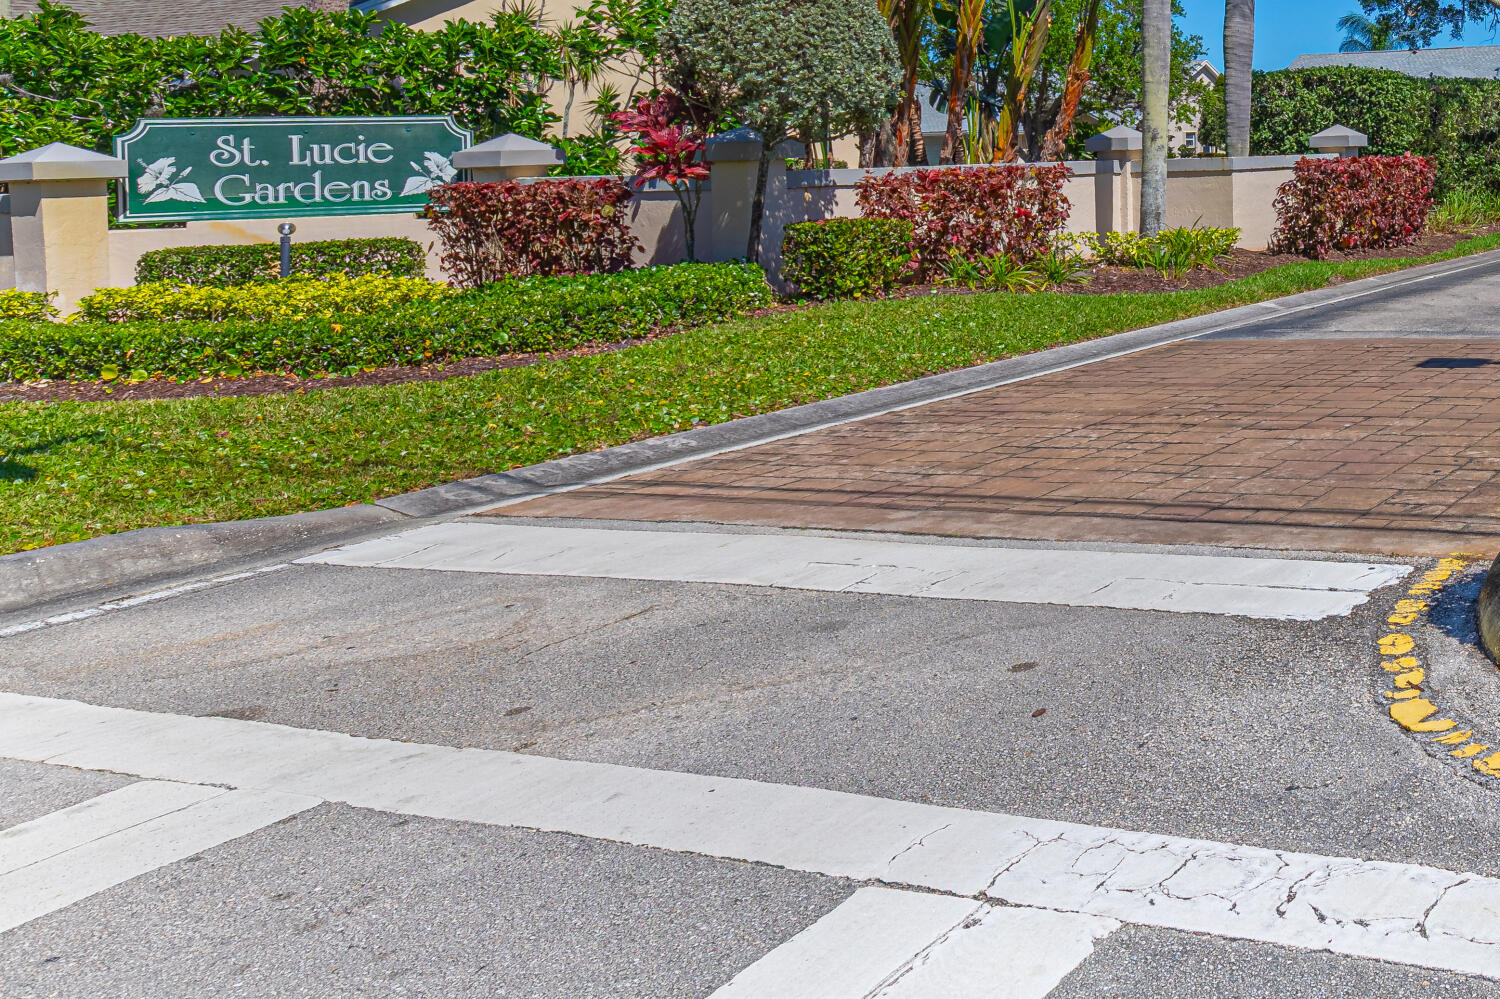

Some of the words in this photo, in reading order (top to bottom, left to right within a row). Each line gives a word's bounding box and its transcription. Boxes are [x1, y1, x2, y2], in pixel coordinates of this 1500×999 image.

[209, 134, 270, 167] St.
[288, 134, 394, 166] Lucie
[213, 169, 393, 206] Gardens
